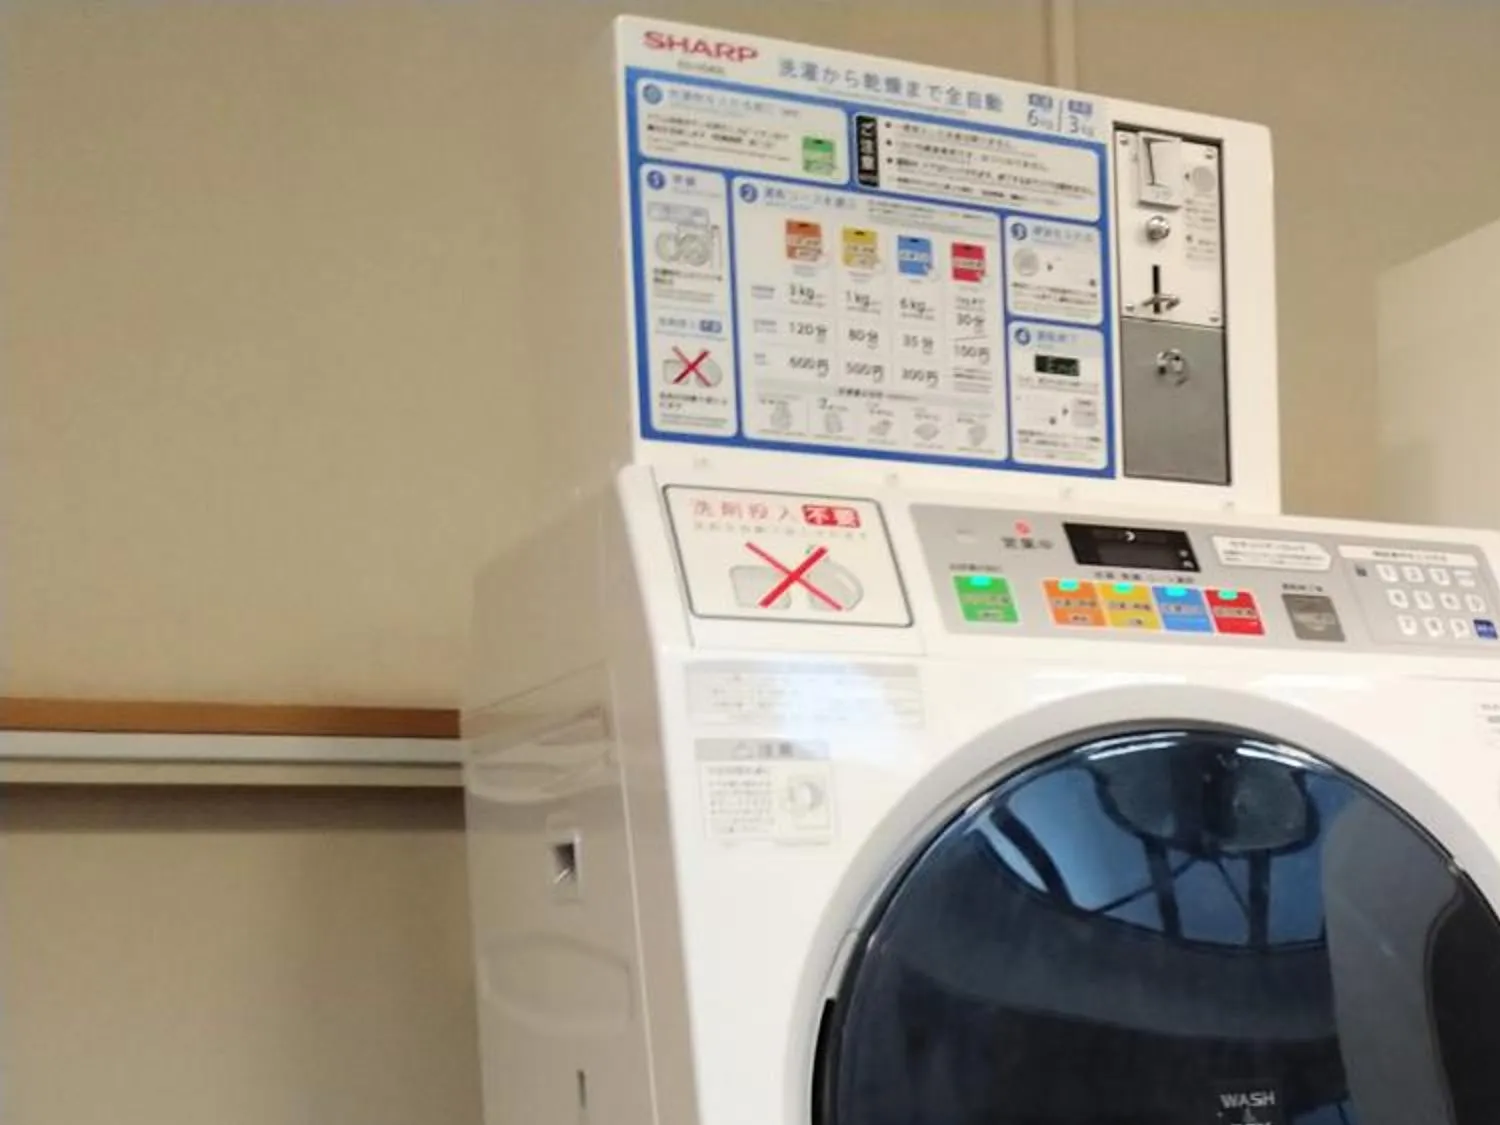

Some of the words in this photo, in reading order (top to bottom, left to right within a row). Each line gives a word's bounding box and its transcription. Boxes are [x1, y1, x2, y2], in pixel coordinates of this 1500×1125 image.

[643, 30, 759, 64] SHARP
[778, 56, 1004, 113] 洗濯から乾燥まで全自動
[694, 501, 796, 523] 洗剤投入
[1220, 1091, 1275, 1108] WASH
